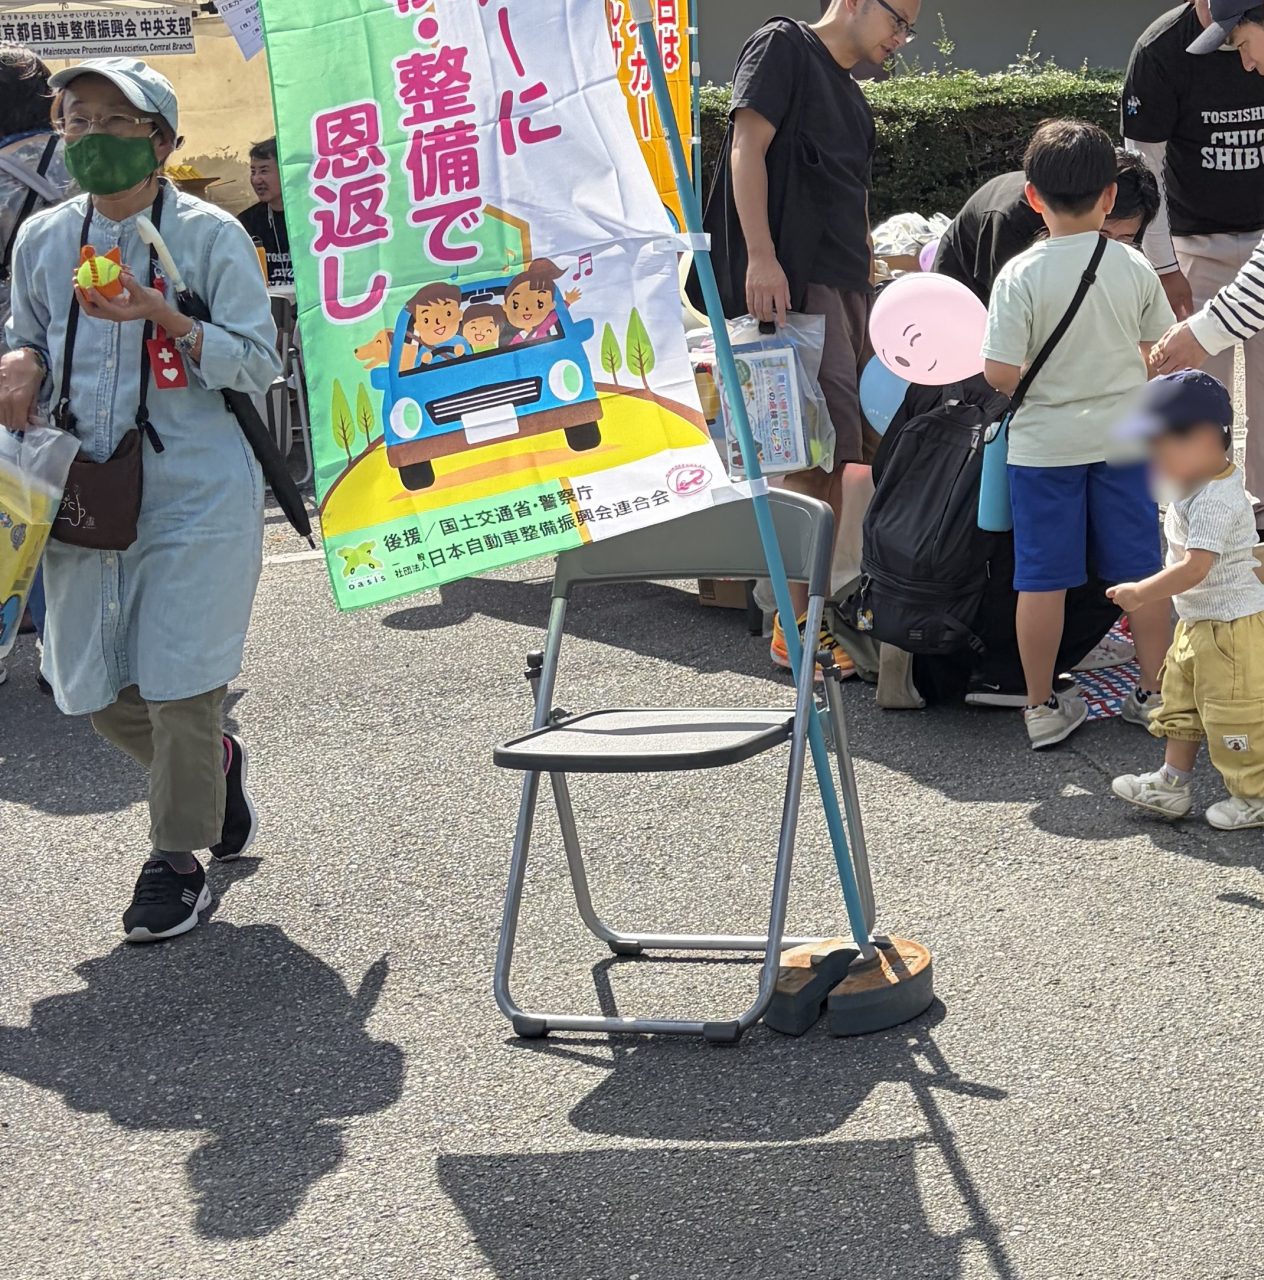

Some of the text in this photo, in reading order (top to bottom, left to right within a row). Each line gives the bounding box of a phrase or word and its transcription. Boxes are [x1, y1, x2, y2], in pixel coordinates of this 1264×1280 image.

[141, 16, 192, 37] 中央支部
[43, 45, 81, 56] Maintenance
[82, 44, 112, 55] Promotion
[114, 43, 149, 54] Association,
[150, 42, 171, 52] Central
[172, 41, 193, 51] Branch
[313, 104, 389, 320] 恩返し
[429, 489, 670, 567] 日本自動車整備振興会連合会
[348, 575, 387, 591] oasis
